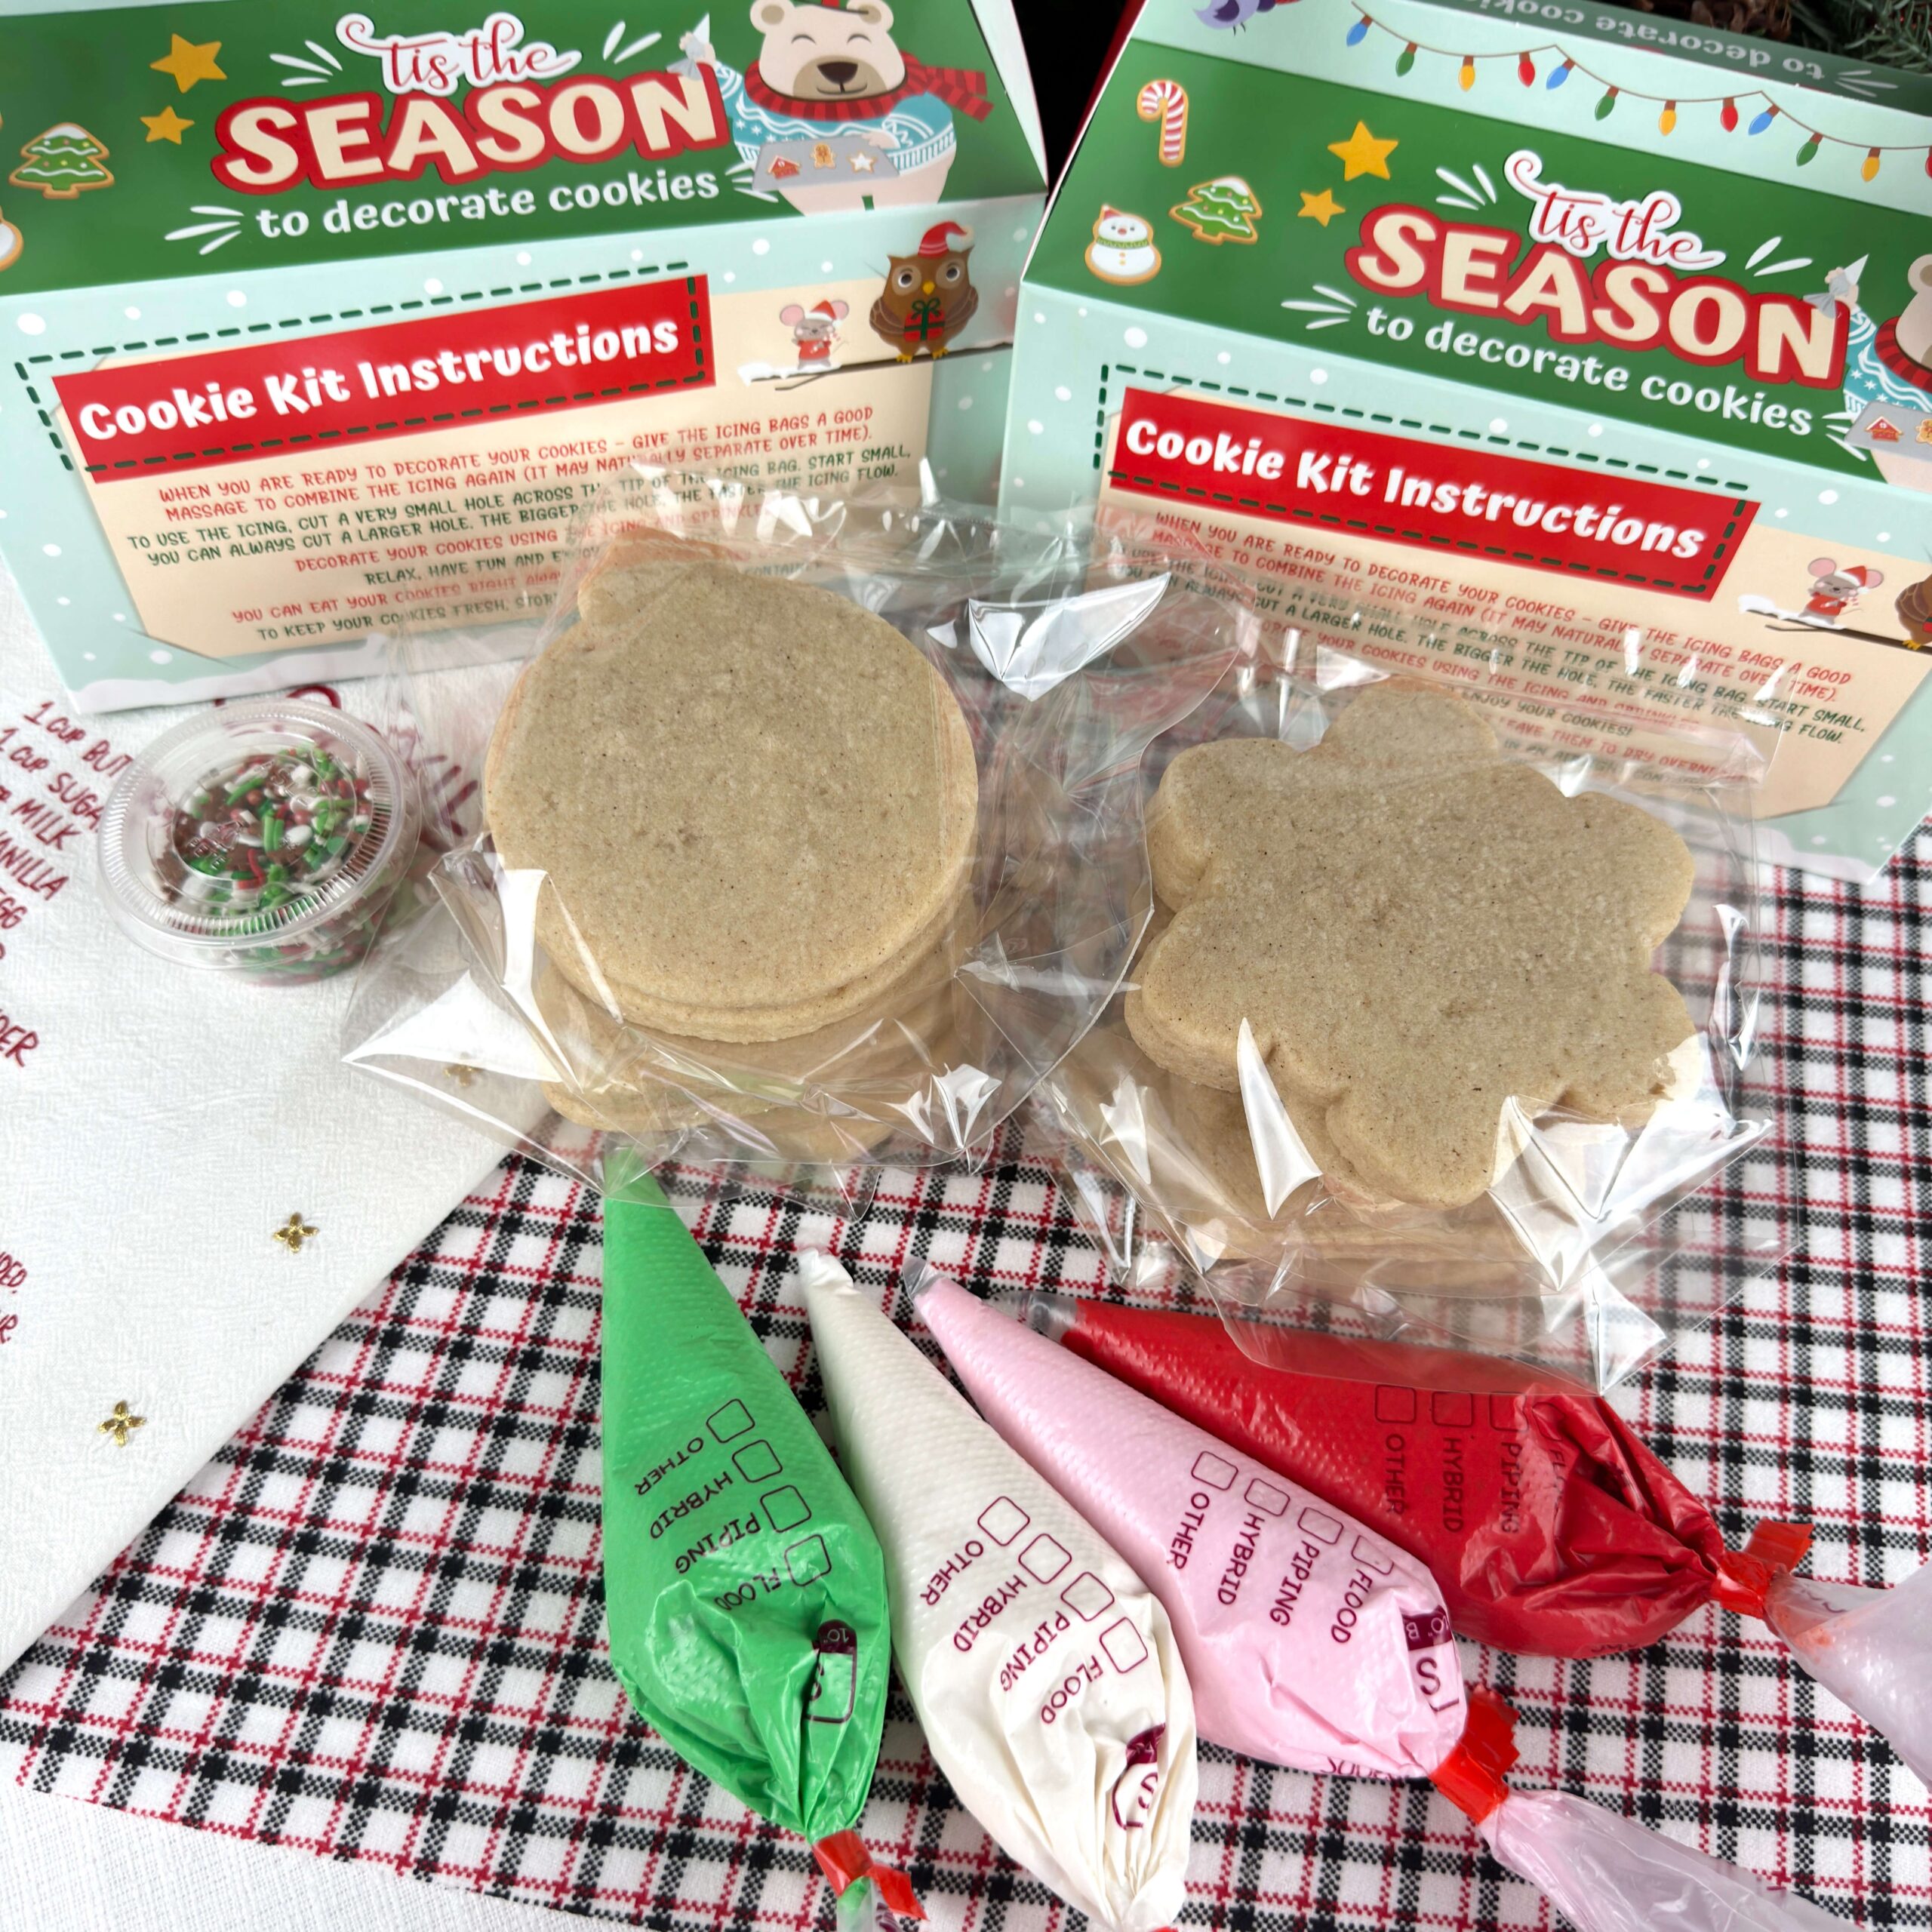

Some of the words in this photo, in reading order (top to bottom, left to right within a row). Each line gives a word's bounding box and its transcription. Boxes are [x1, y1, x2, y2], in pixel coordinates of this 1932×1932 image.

[458, 19, 572, 85] the
[1595, 14, 1771, 69] decorate
[1783, 57, 1825, 82] to
[226, 78, 717, 185] SEASON
[256, 209, 309, 238] to
[323, 189, 536, 233] decorate
[548, 168, 720, 212] cookies
[1607, 198, 1714, 265] the
[1358, 213, 1847, 380] SEASON
[78, 380, 257, 442] Cookie
[264, 365, 352, 416] Kit
[361, 320, 680, 400] Instructions
[1366, 306, 1414, 342] to
[1426, 321, 1629, 392] decorate
[1641, 370, 1815, 438] cookies
[158, 485, 211, 503] WHEN
[217, 478, 251, 497] YOU
[260, 474, 294, 493] ARE
[301, 467, 358, 488] READY
[365, 465, 387, 479] TO
[395, 454, 481, 478] DECORATE
[488, 447, 531, 468] YOUR
[538, 438, 608, 460] COOKIES
[632, 432, 669, 450] GIVE
[678, 426, 709, 445] THE
[716, 421, 761, 439] ICING
[768, 414, 811, 432] BAGS
[817, 412, 828, 426] A
[833, 407, 875, 425] GOOD
[165, 500, 249, 522] MASSAGE
[255, 497, 278, 512] TO
[284, 487, 361, 509] COMBINE
[367, 483, 402, 500] THE
[408, 475, 457, 495] ICING
[465, 469, 516, 489] AGAIN
[523, 464, 549, 484] (IT
[555, 459, 589, 479] MAY
[693, 438, 773, 462] SEPARATE
[780, 434, 817, 451] OVER
[1124, 419, 1284, 481] Cookie
[1297, 451, 1377, 496] Kit
[1384, 467, 1708, 559] Instructions
[127, 534, 151, 551] TO
[156, 530, 191, 548] USE
[195, 525, 232, 542] THE
[298, 514, 330, 531] CUT
[338, 512, 351, 527] A
[355, 506, 398, 524] VERY
[405, 498, 457, 519] SMALL
[464, 493, 506, 512] HOLE
[512, 486, 574, 506] ACROSS
[619, 478, 645, 493] TIP
[808, 451, 856, 470] START
[147, 549, 180, 567] YOU
[188, 546, 223, 562] CAN
[229, 537, 297, 558] ALWAYS
[303, 533, 333, 549] CUT
[341, 531, 354, 545] A
[358, 521, 422, 543] LARGER
[480, 509, 513, 526] THE
[808, 469, 851, 486] ICING
[857, 464, 898, 482] FLOW.
[294, 551, 380, 573] DECORATE
[386, 543, 429, 561] YOUR
[435, 536, 503, 556] COOKIES
[510, 531, 558, 548] USING
[428, 559, 469, 578] HAVE
[475, 555, 507, 572] FUN
[514, 551, 546, 567] AND
[232, 607, 263, 623] YOU
[270, 603, 303, 620] CAN
[309, 598, 340, 614] EAT
[346, 592, 389, 609] YOUR
[257, 627, 278, 641] TO
[284, 620, 327, 637] KEEP
[332, 614, 374, 632] YOUR
[1155, 512, 1201, 534] WHEN
[1208, 525, 1238, 543] YOU
[1242, 534, 1277, 553] ARE
[1282, 543, 1336, 566] READY
[1343, 557, 1361, 573] TO
[1367, 564, 1451, 594] DECORATE
[1458, 583, 1500, 602] YOUR
[1504, 595, 1577, 623] COOKIES
[1645, 627, 1678, 647] THE
[1684, 638, 1732, 659] ICING
[1737, 650, 1785, 672] BAGS
[1789, 662, 1803, 674] A
[1806, 666, 1854, 685] GOOD
[1232, 549, 1251, 565] TO
[1255, 556, 1324, 583] COMBINE
[1333, 573, 1363, 592] THE
[1368, 582, 1417, 604] ICING
[1423, 595, 1476, 619] AGAIN
[1480, 607, 1508, 626] (IT
[1511, 617, 1547, 635] MAY
[1649, 647, 1736, 678] SEPARATE
[1285, 604, 1297, 617] A
[1300, 607, 1362, 632] LARGER
[1416, 633, 1447, 652] THE
[1452, 643, 1515, 667] BIGGER
[1521, 658, 1551, 675] THE
[1607, 679, 1635, 696] THE
[1644, 683, 1706, 712] FASTER
[1798, 724, 1842, 744] FLOW.
[1361, 643, 1427, 669] COOKIES
[1432, 661, 1481, 681] USING
[1487, 672, 1518, 691] THE
[1525, 641, 1557, 659] THE
[1563, 651, 1590, 667] TIP
[1595, 658, 1619, 672] OF
[23, 700, 55, 726] 1
[46, 716, 87, 744] CUP
[1516, 703, 1557, 718] YOUR
[1561, 712, 1635, 738] COOKIES!
[1552, 729, 1594, 748] THEM
[1598, 741, 1619, 755] TO
[1623, 746, 1656, 764] DRY
[9, 746, 50, 774] CUP
[48, 771, 106, 832] SUGA
[11, 798, 82, 851] MILK
[633, 1435, 705, 1497] OTHER
[1384, 1435, 1406, 1516] OTHER
[1442, 1437, 1465, 1534] HYBRID
[1499, 1441, 1523, 1534] PIPING
[649, 1471, 734, 1540] HYBRID
[674, 1511, 762, 1575] PIPING
[1169, 1491, 1211, 1571] OTHER
[919, 1540, 985, 1607] OTHER
[1217, 1512, 1266, 1606] HYBRID
[1269, 1540, 1321, 1627] PIPING
[952, 1574, 1028, 1654] HYBRID
[1330, 1569, 1374, 1644] FLOOD
[999, 1610, 1071, 1693] PIPING
[1040, 1654, 1104, 1725] FLOOD
